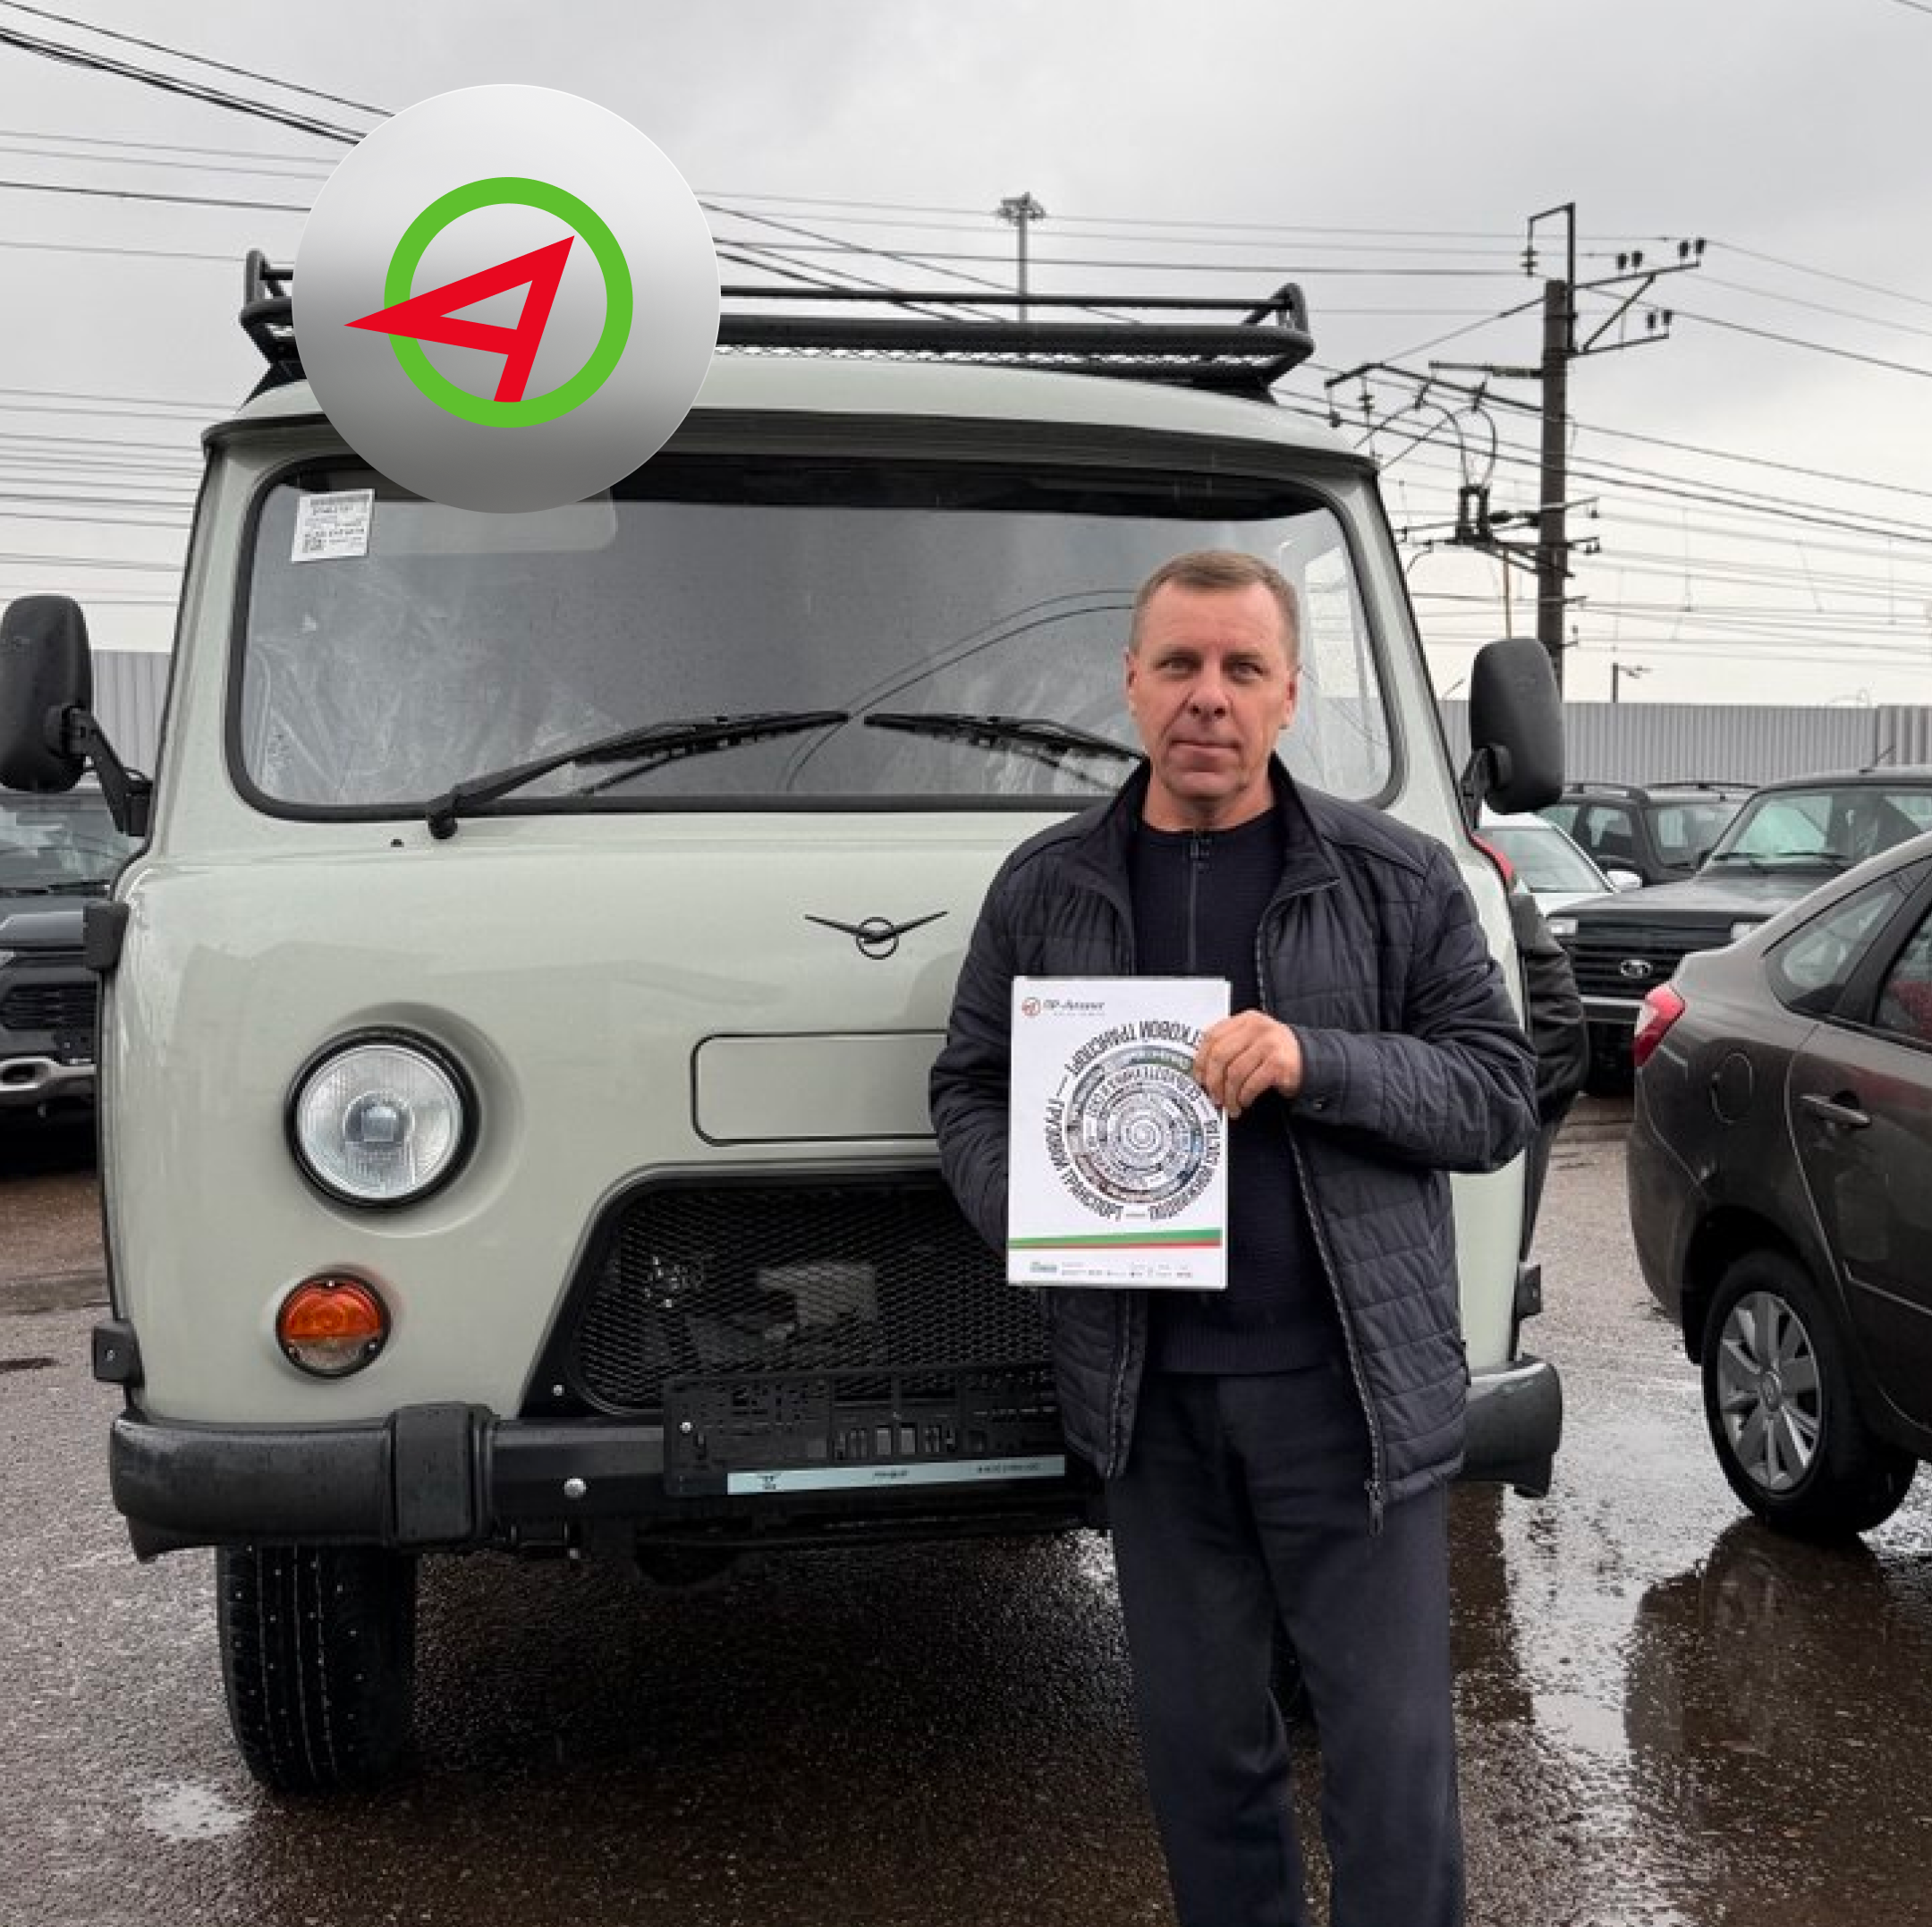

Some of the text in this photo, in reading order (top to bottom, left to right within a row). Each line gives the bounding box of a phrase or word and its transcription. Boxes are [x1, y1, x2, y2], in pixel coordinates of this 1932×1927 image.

[1064, 1023, 1137, 1077] ТРАНСПОРТ
[1045, 1098, 1071, 1170] ГРУЗОВОЙ
[1060, 1167, 1124, 1222] ТРАНСПОРТ
